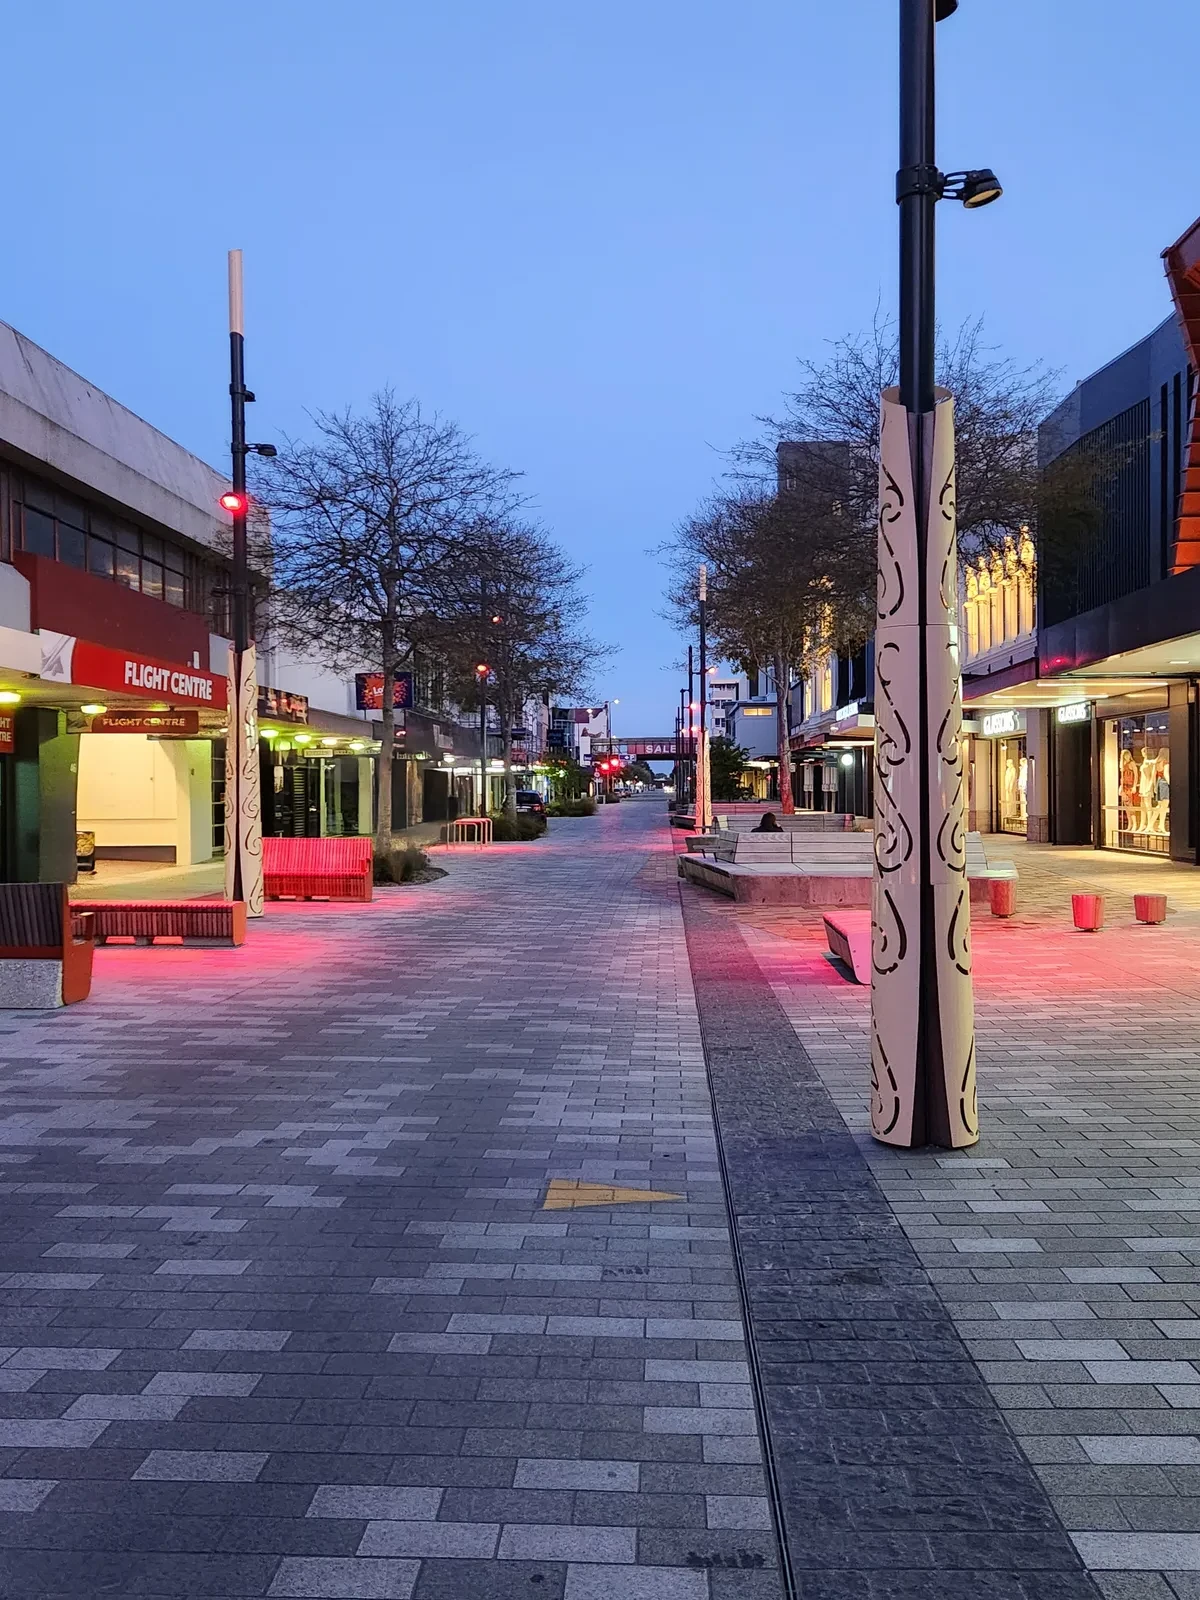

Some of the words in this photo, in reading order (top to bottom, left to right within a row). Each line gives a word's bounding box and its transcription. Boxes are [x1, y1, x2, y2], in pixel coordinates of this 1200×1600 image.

[124, 660, 170, 692] FLIGHT
[171, 671, 213, 701] CENTRE
[102, 718, 142, 727] FLIGHT
[143, 718, 185, 727] CENTRE
[645, 744, 677, 754] SALE
